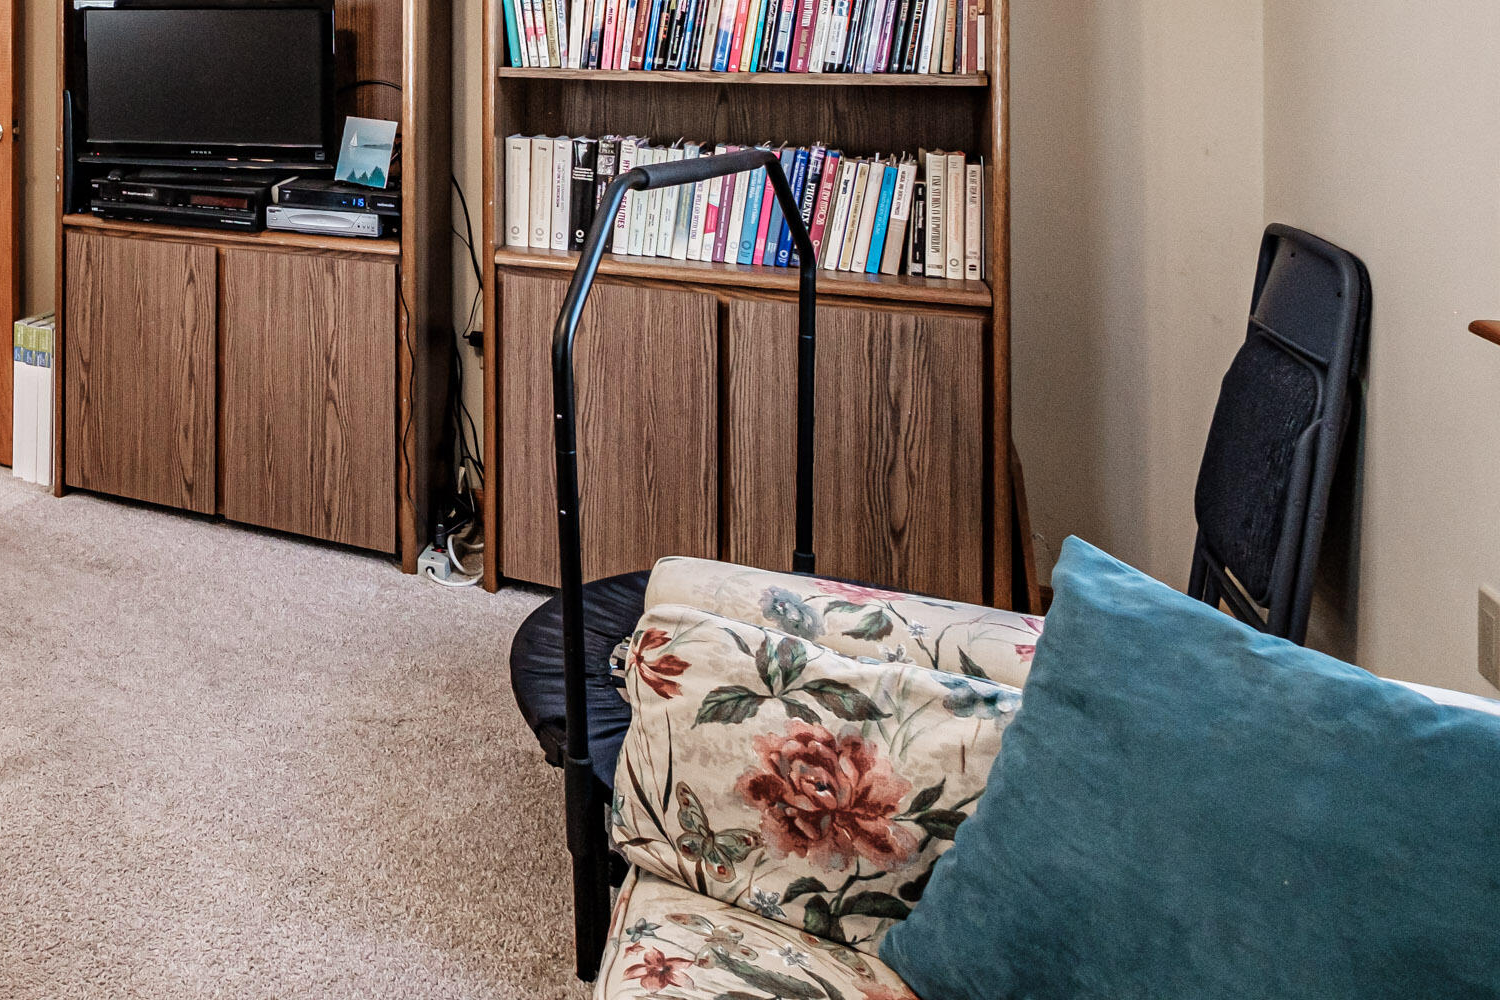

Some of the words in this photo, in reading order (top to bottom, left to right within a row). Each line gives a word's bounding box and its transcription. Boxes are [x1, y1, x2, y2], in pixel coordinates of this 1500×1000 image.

[914, 12, 921, 21] Is
[931, 175, 941, 186] CASE
[801, 182, 816, 224] PHOENIX
[931, 188, 941, 209] STUDIES
[617, 196, 627, 229] REALITIES
[931, 216, 941, 254] HYPNOTHERAPY
